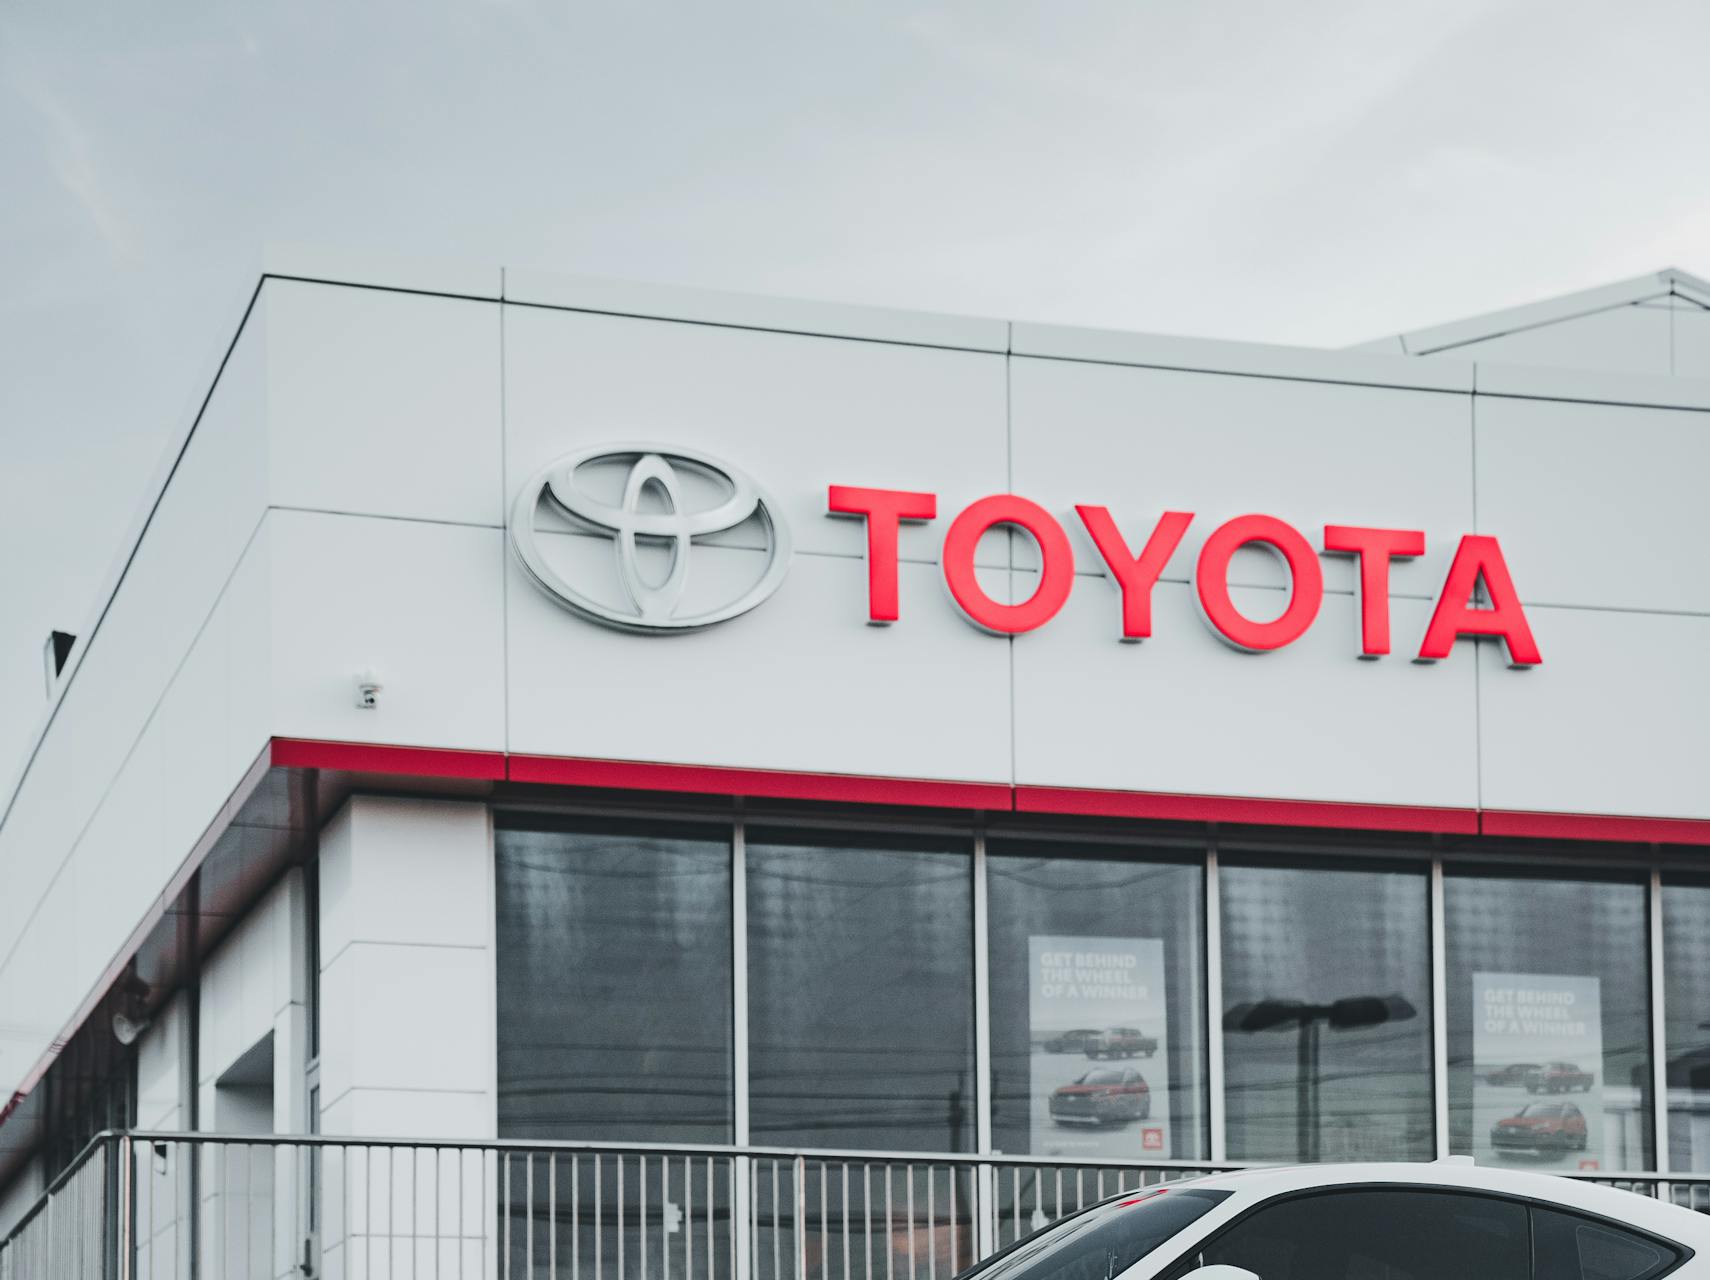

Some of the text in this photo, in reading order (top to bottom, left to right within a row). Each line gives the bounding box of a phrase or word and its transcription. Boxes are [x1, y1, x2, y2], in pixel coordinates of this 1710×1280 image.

[827, 484, 1543, 666] TOYOTA
[1040, 952, 1137, 968] GET BEHIND
[1040, 968, 1132, 984] THE WHEEL
[1040, 984, 1149, 1000] OF A WINNER
[1484, 988, 1575, 1005] GET BEHIND
[1485, 1004, 1570, 1020] THE WHEEL
[1484, 1020, 1585, 1035] OF A WINNER
